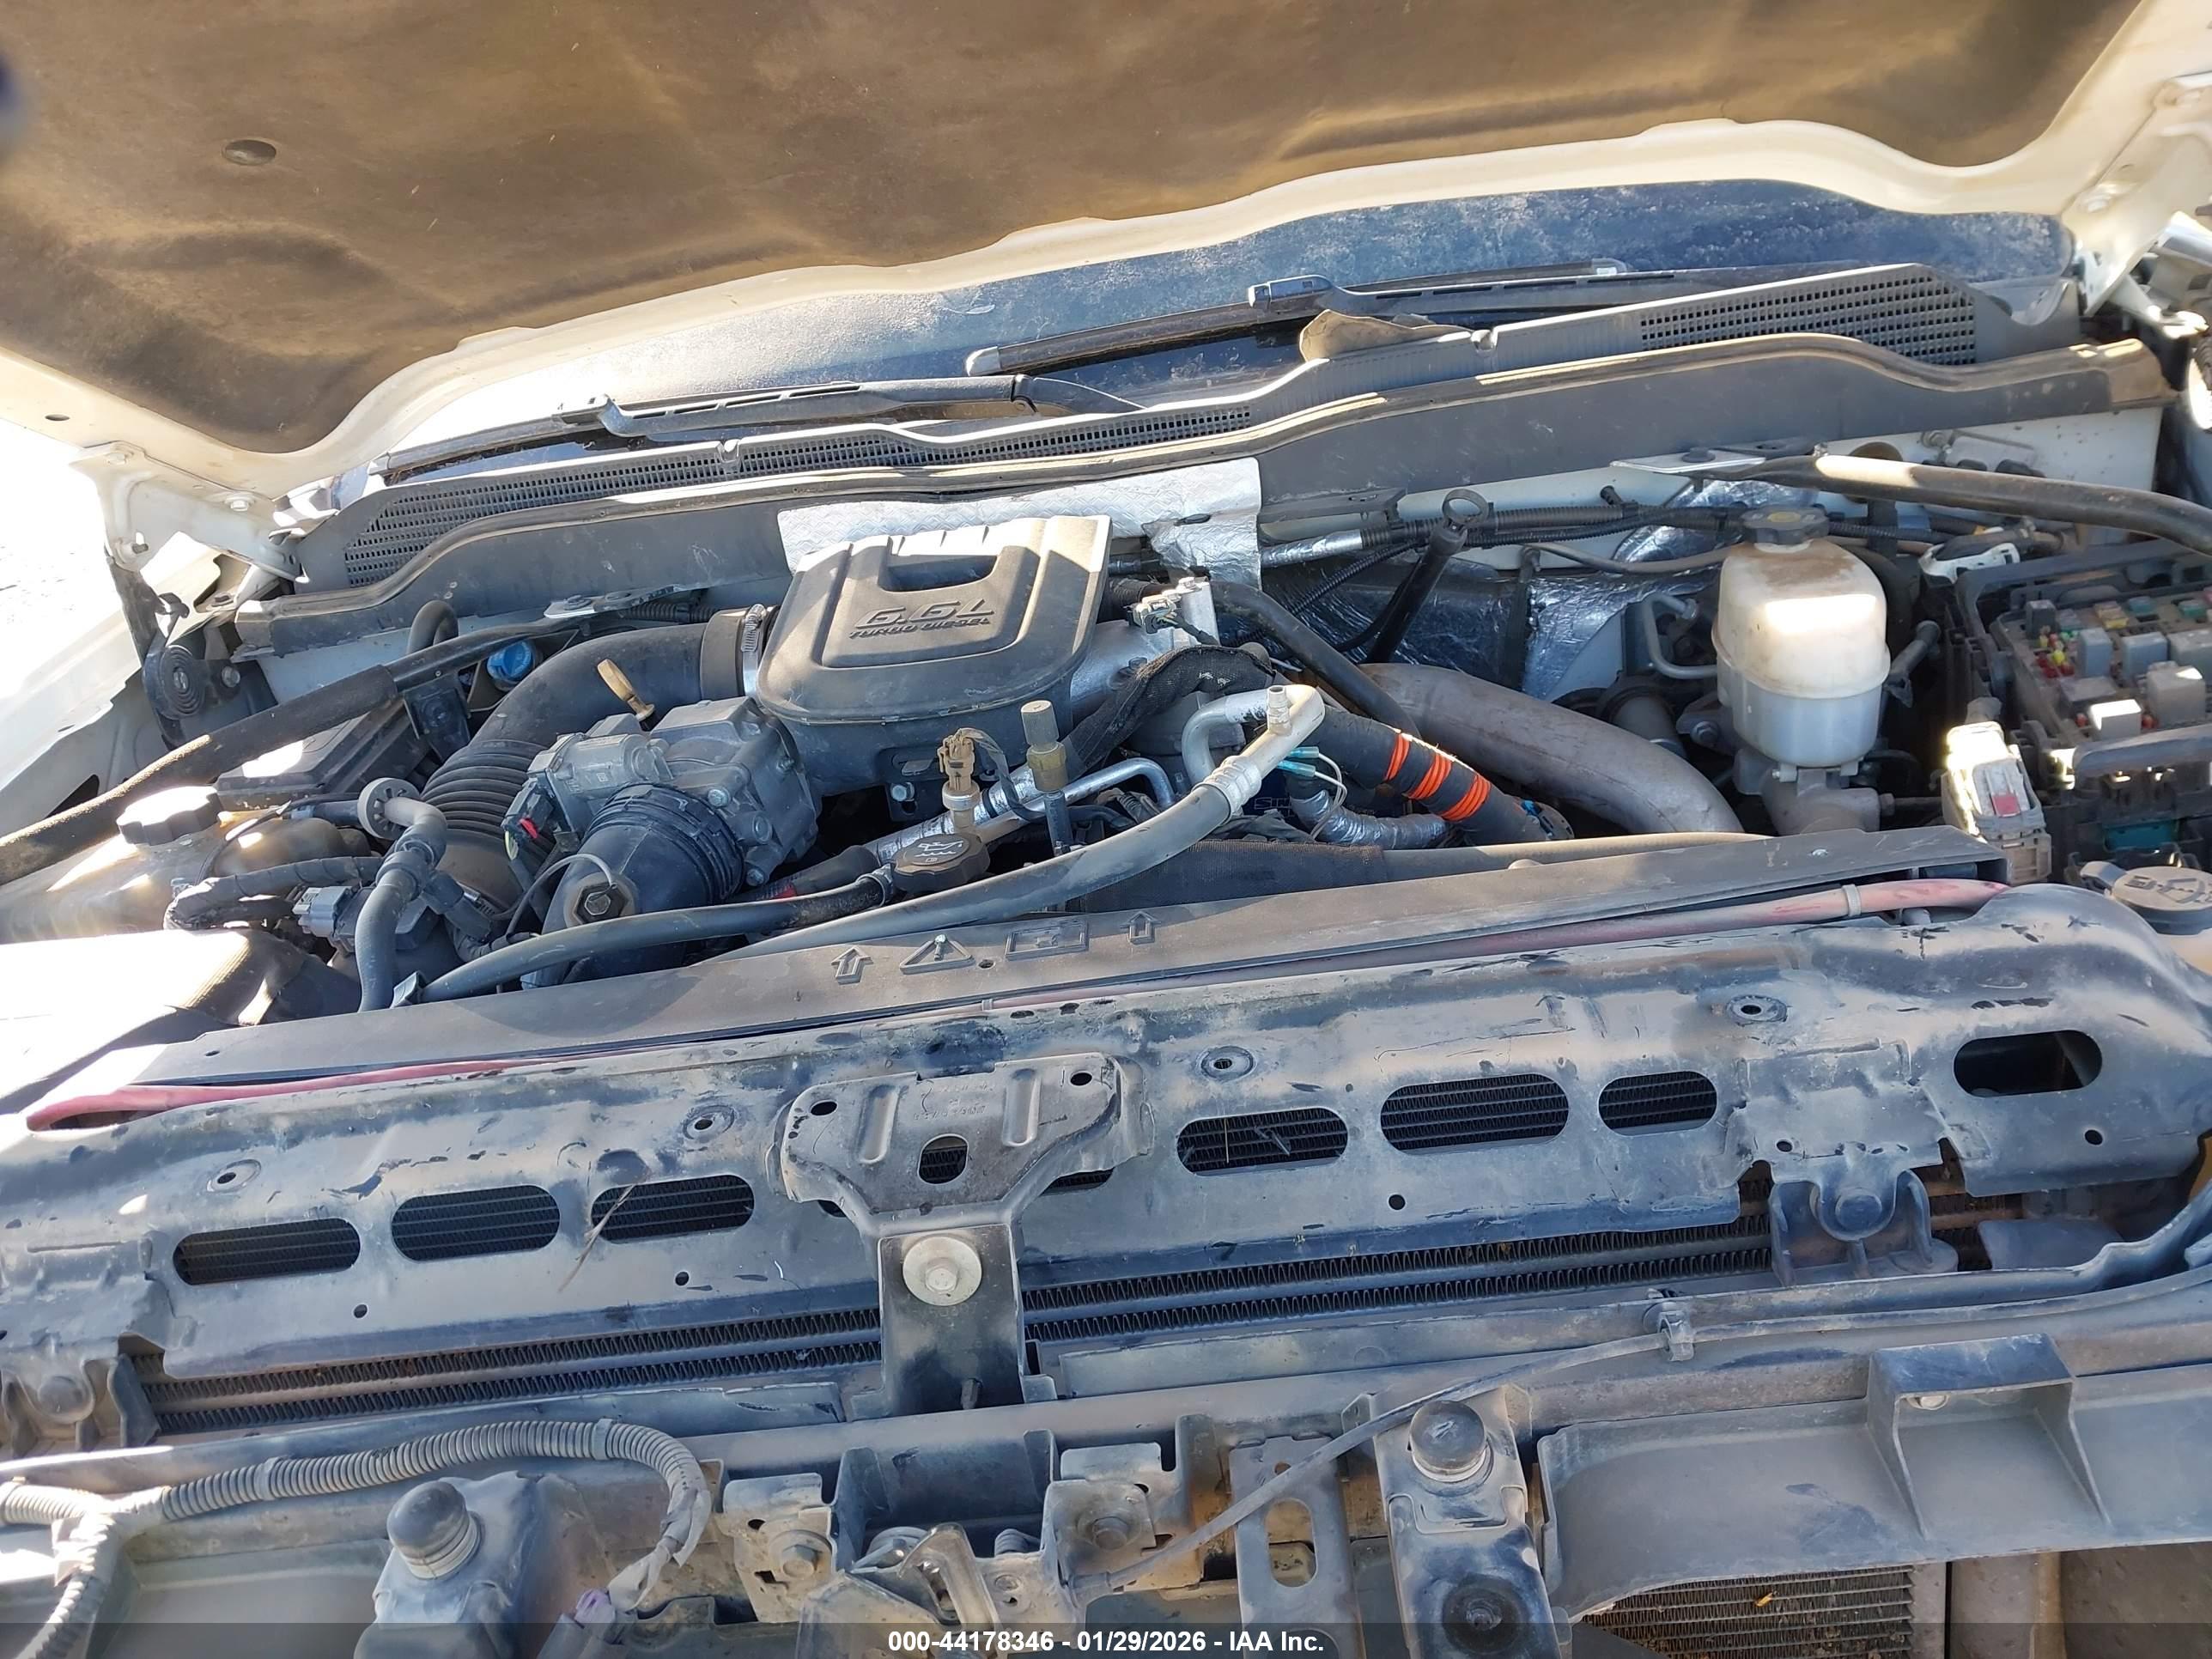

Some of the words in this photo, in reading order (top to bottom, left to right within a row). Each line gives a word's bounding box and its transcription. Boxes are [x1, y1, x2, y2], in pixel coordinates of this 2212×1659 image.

[854, 598, 994, 629] 6.6L
[848, 623, 918, 639] TURBO
[921, 617, 991, 631] DIESEL
